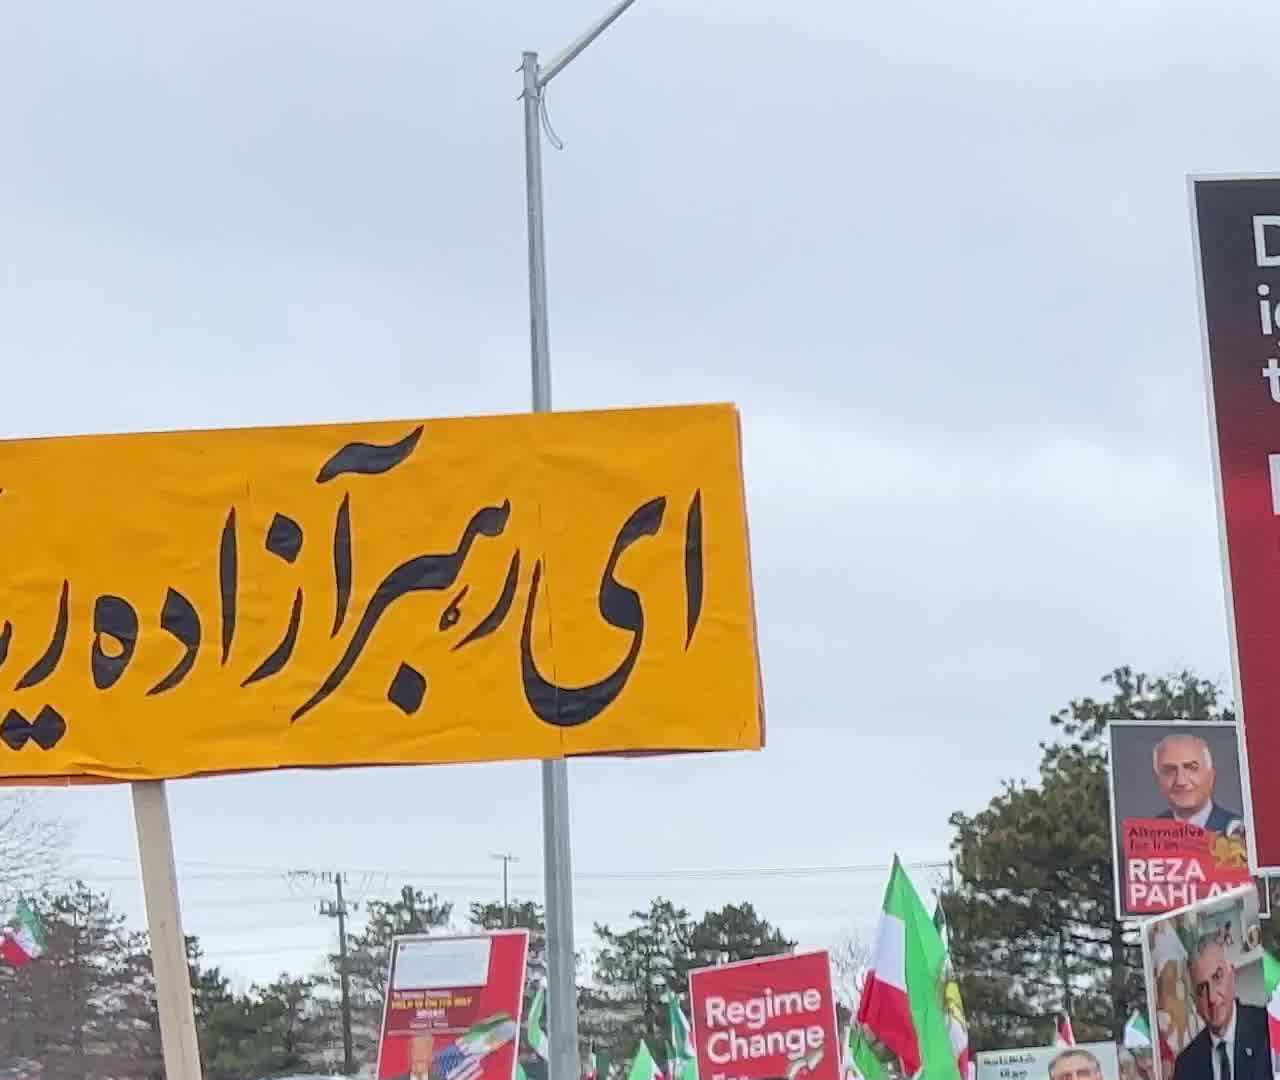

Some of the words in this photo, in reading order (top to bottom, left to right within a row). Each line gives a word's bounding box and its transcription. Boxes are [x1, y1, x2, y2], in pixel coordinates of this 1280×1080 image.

[90, 425, 425, 697] آزاده
[291, 497, 521, 724] رهبر
[521, 487, 704, 726] ای
[1128, 857, 1207, 882] REZA
[705, 987, 822, 1030] Regime
[707, 1024, 825, 1065] Change
